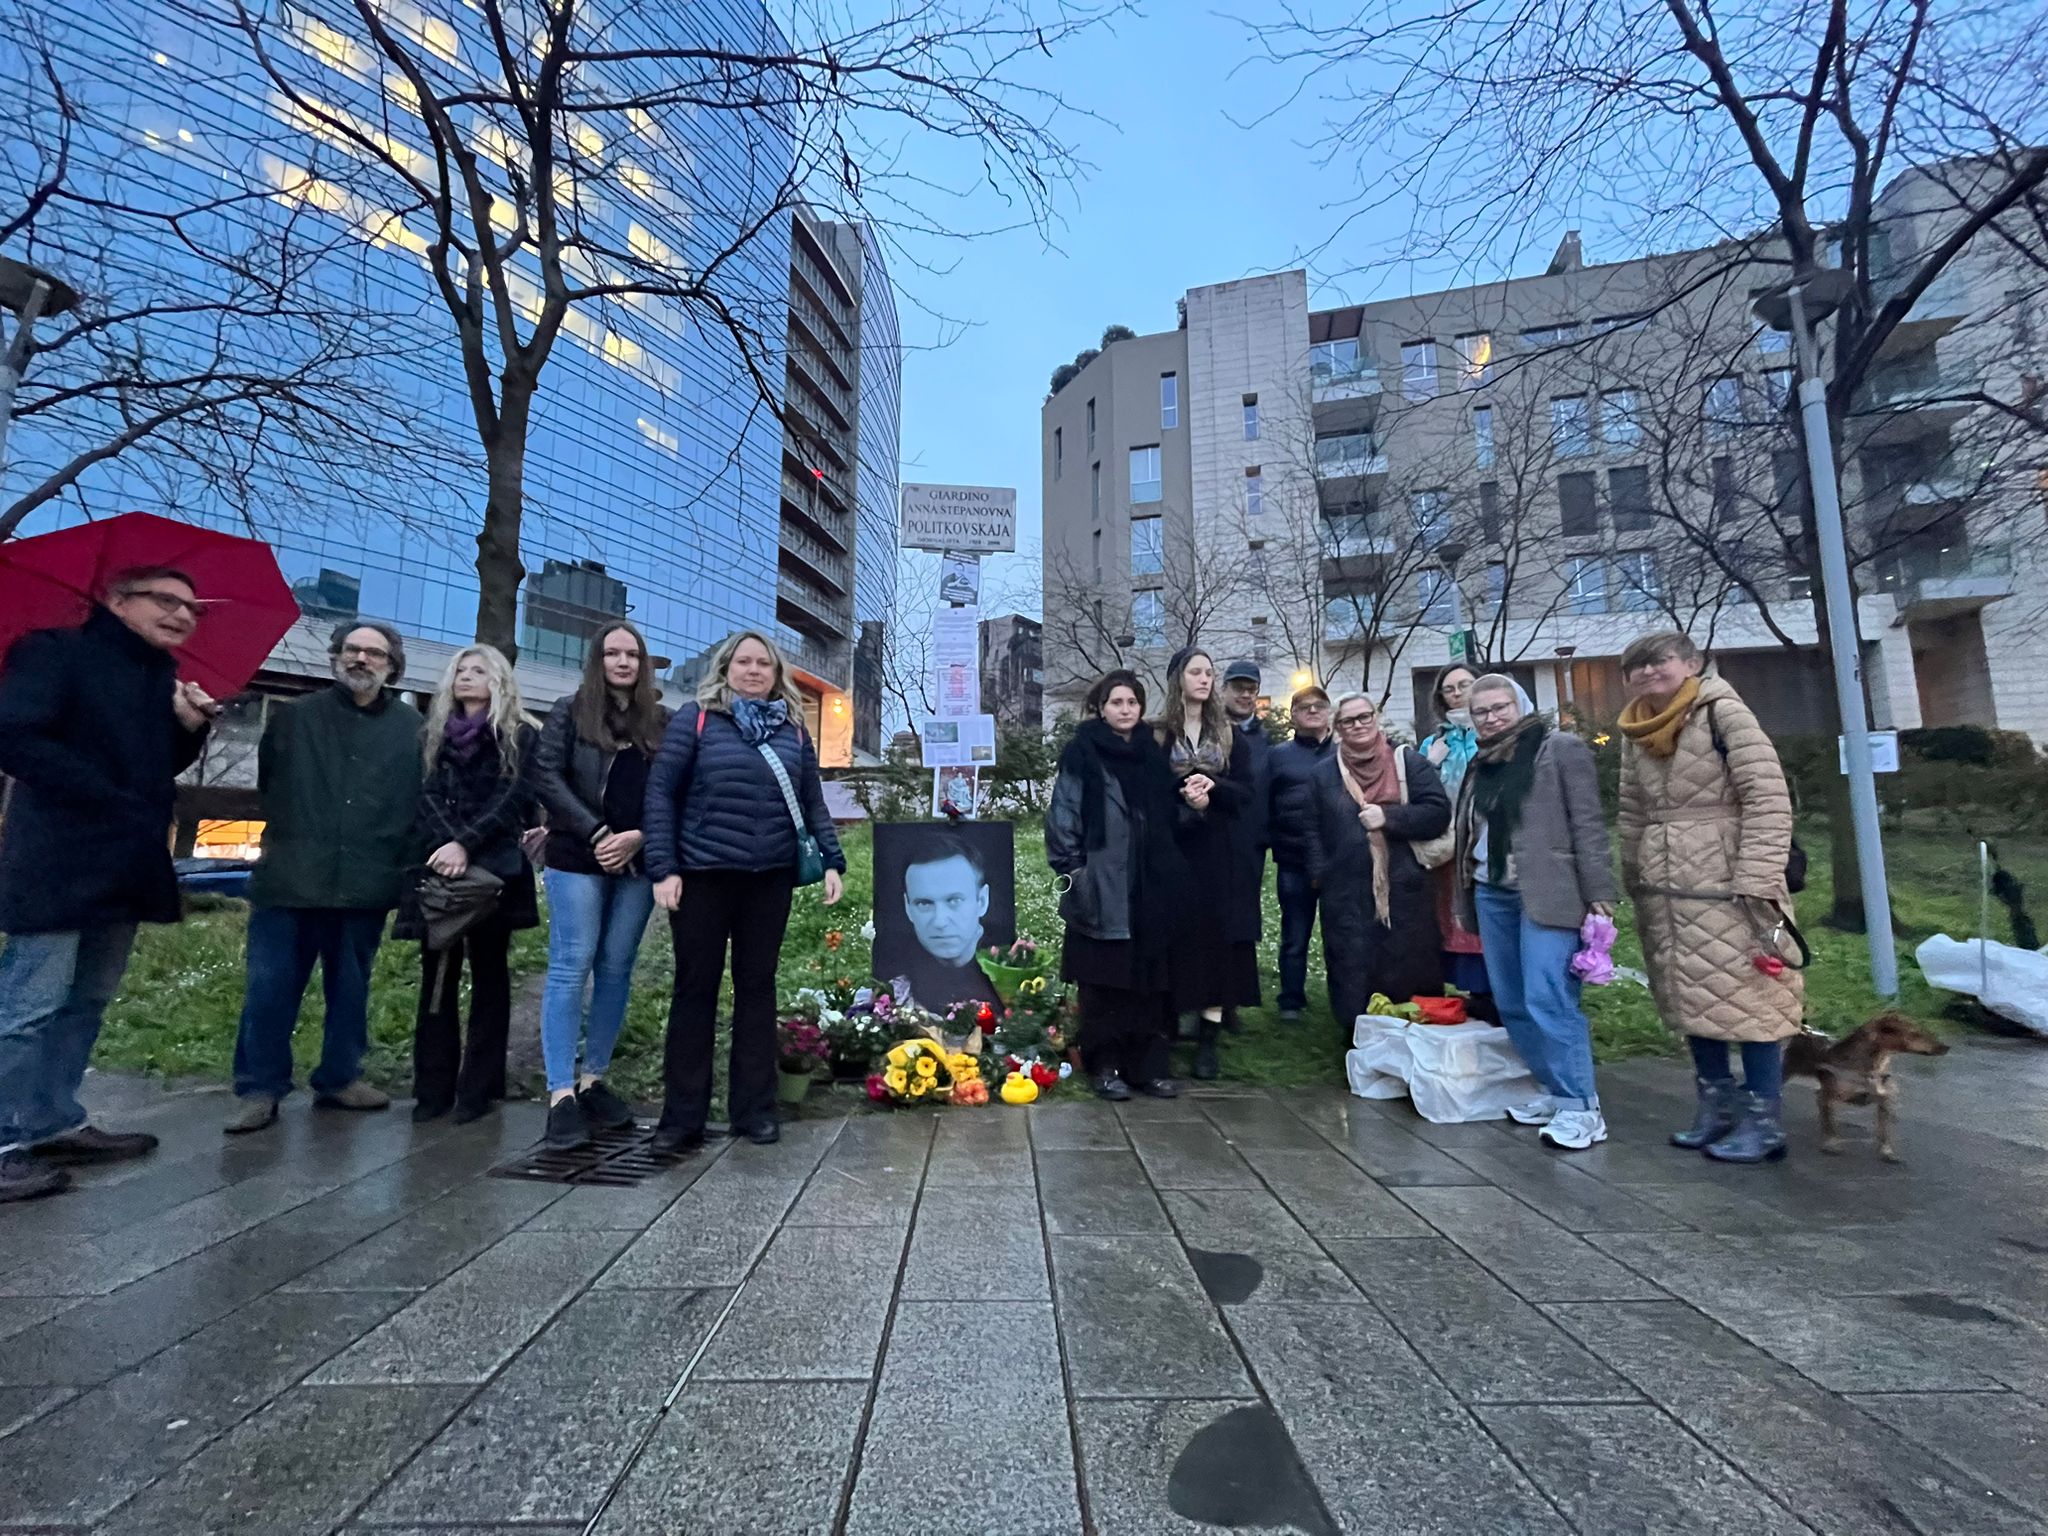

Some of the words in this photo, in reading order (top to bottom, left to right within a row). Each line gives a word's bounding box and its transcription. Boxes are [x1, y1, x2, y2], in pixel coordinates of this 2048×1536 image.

[929, 490, 989, 502] GIARDINO
[908, 504, 938, 514] ANNA
[941, 506, 1011, 518] STEPANOVNA
[908, 520, 1010, 537] POLITKOVSKAJA
